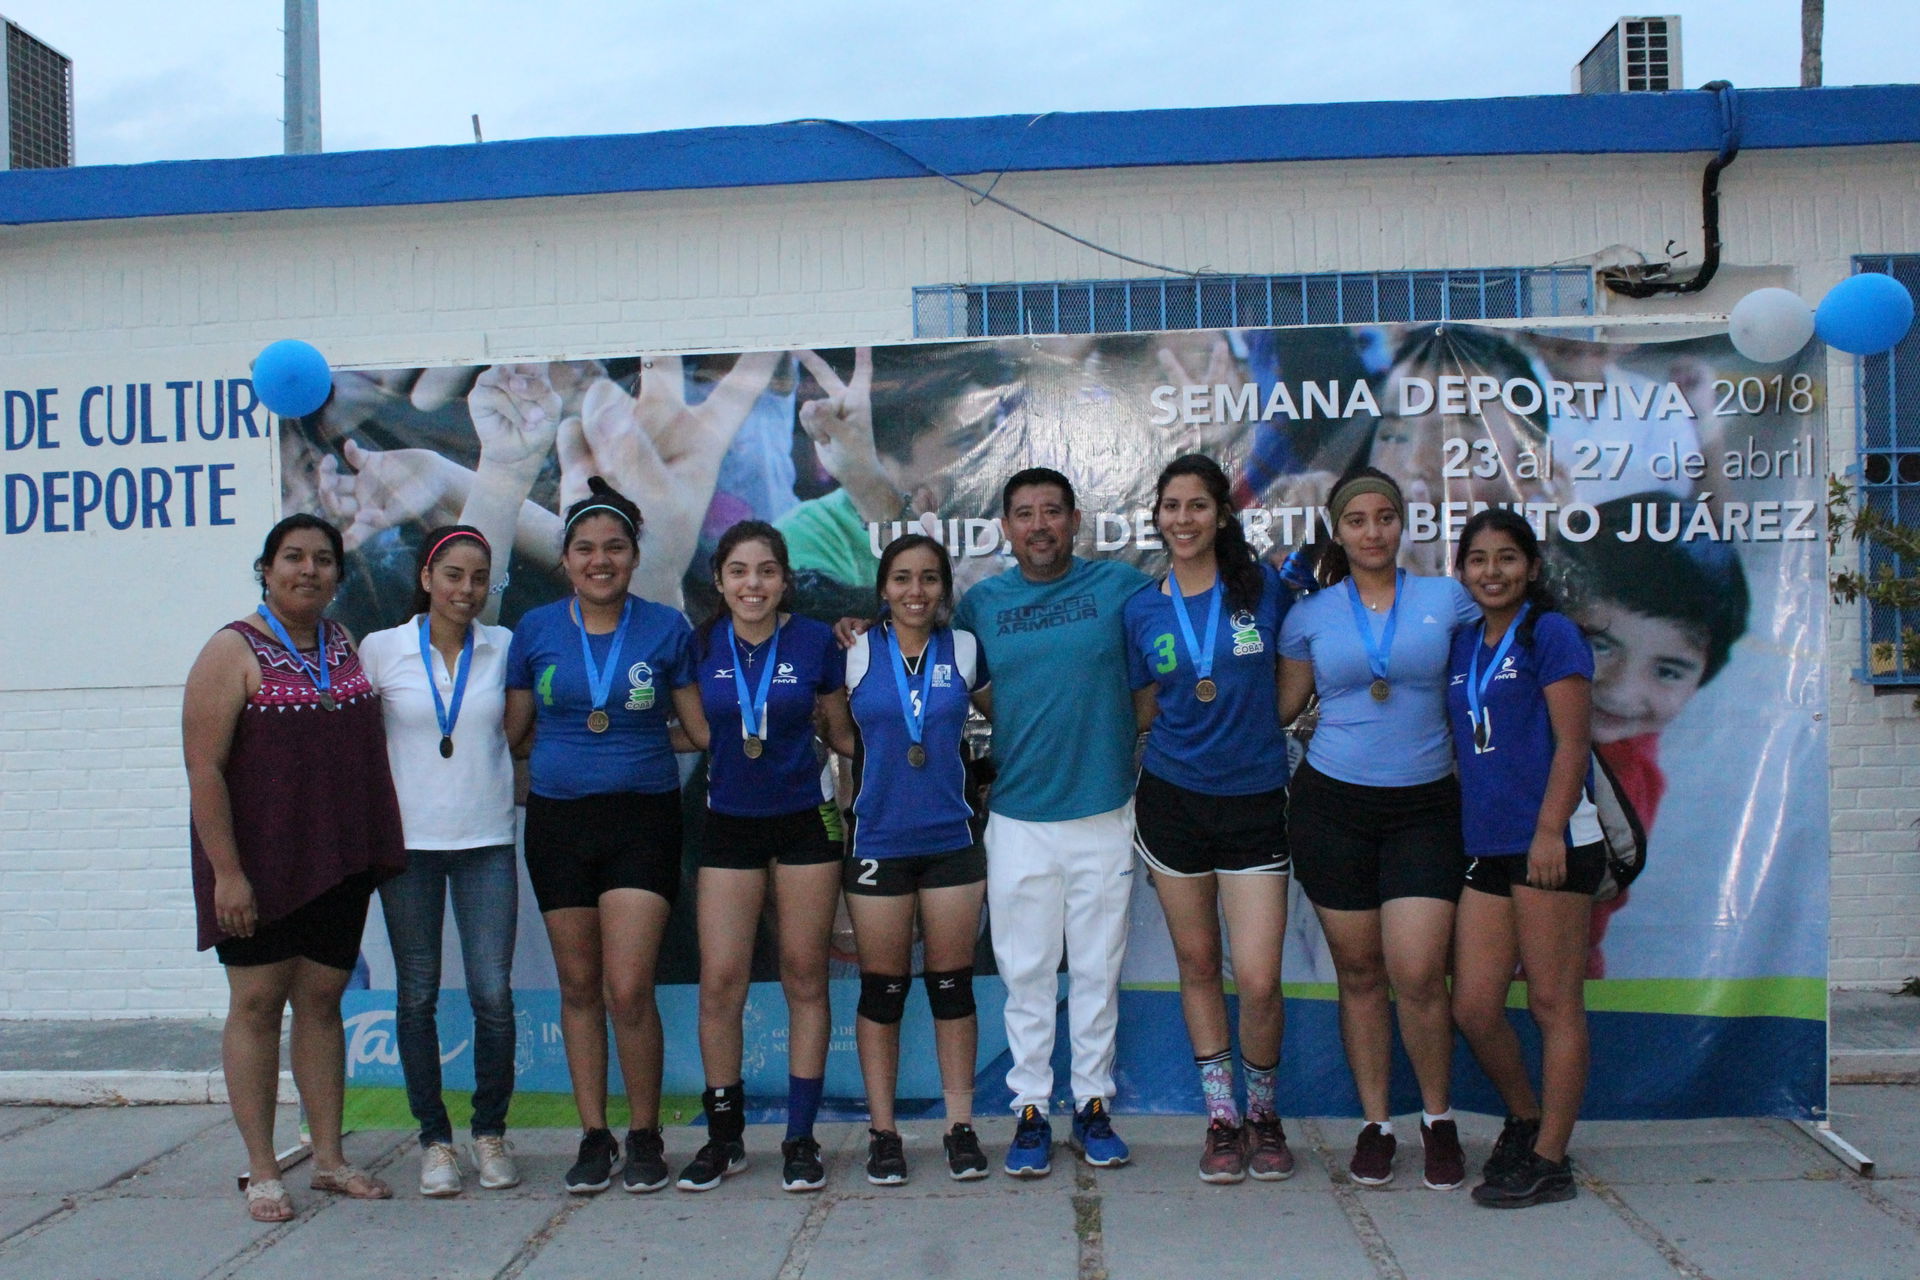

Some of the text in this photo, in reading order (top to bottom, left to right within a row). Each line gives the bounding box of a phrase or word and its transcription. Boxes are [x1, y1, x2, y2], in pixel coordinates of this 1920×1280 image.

[4, 378, 271, 451] DE CULTUR
[1150, 373, 1814, 425] SEMANA DEPORTIVA 2018
[1442, 434, 1815, 480] 23 al 27 de abril
[5, 462, 236, 535] DEPORTE
[869, 518, 1013, 560] UNID
[1615, 491, 1817, 543] JUÁREZ
[996, 607, 1098, 637] ARMOUR
[1153, 632, 1178, 675] 3
[1233, 642, 1264, 655] COBAT
[537, 663, 558, 706] 4
[857, 858, 880, 886] 2
